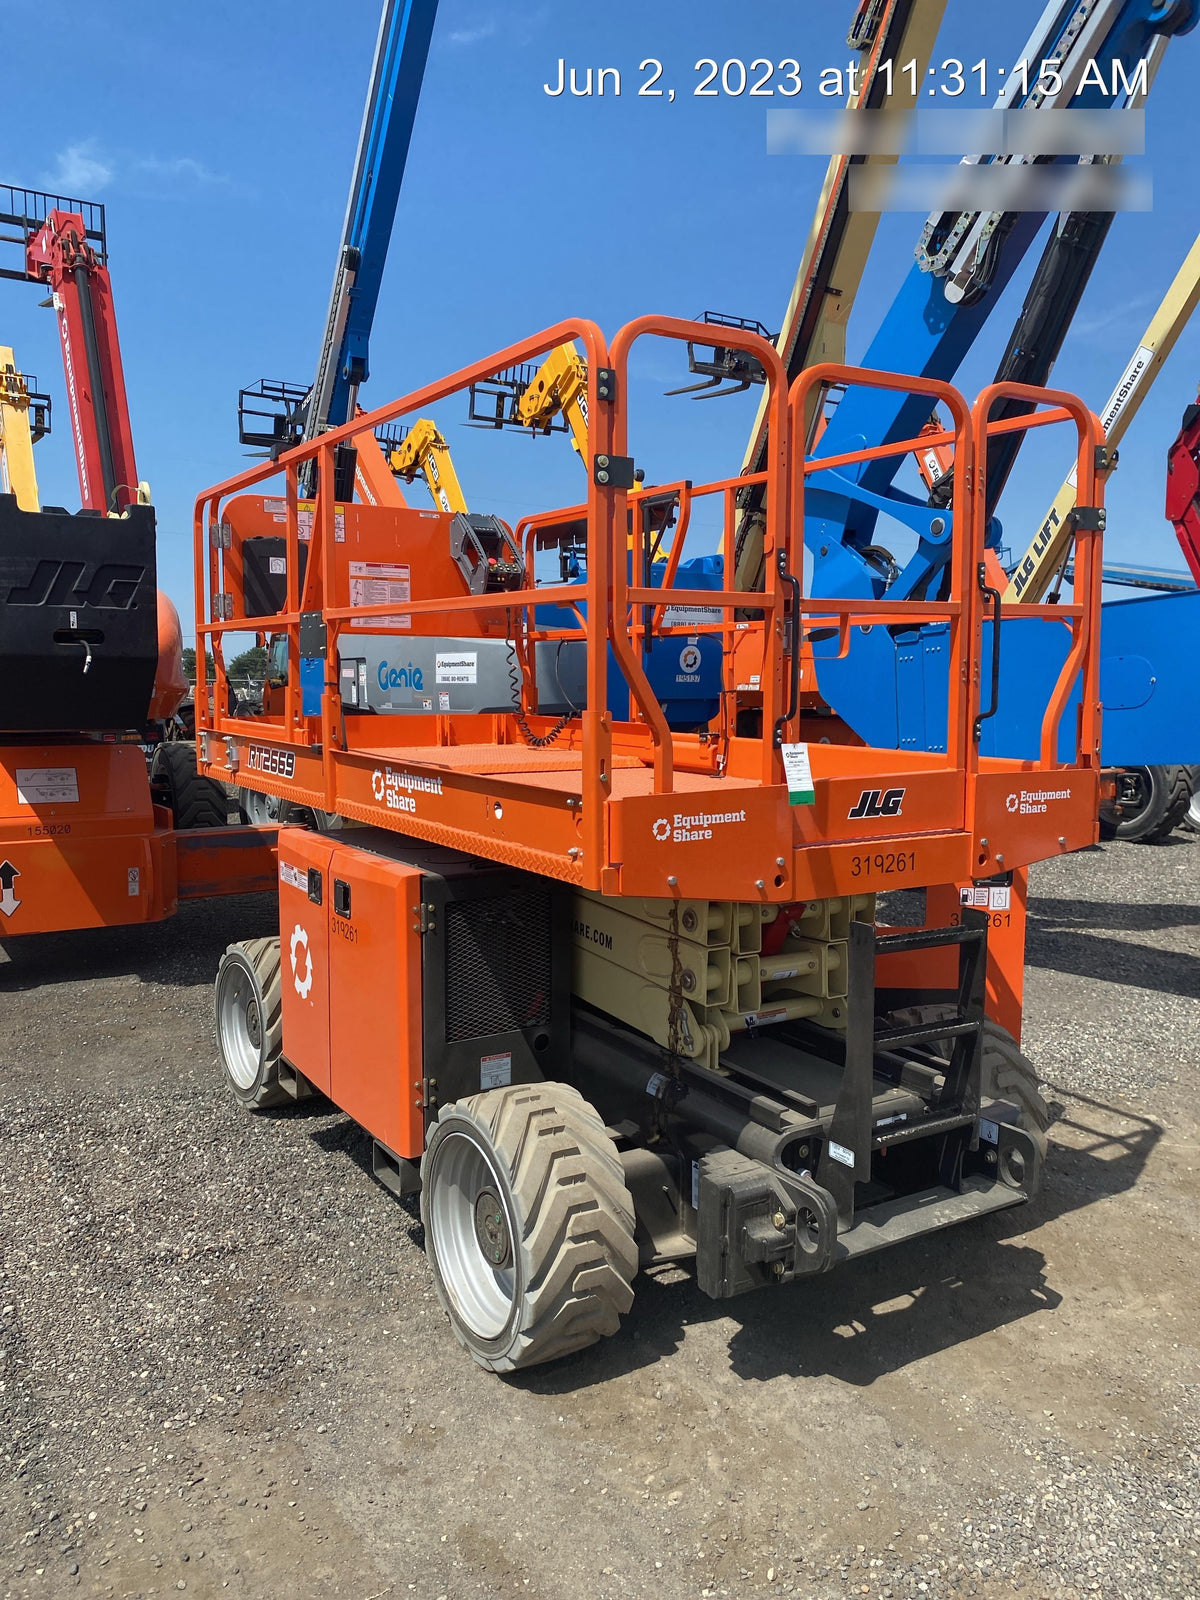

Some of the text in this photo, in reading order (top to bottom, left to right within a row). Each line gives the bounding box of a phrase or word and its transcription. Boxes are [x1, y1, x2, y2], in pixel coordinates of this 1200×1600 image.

[1102, 360, 1144, 433] mentShare
[427, 453, 440, 481] JCB
[1013, 507, 1060, 597] JLG LIFT
[8, 560, 146, 609] JLG
[671, 604, 721, 615] EquipmentShare
[377, 660, 424, 691] Genie
[248, 744, 296, 779] RT2669
[385, 766, 443, 795] Equipment
[385, 788, 416, 813] Share
[847, 787, 906, 820] JLG
[1020, 788, 1071, 802] Equipment
[1020, 801, 1048, 814] Share
[27, 824, 72, 838] 155020
[673, 810, 746, 828] Equipment
[673, 827, 713, 843] Share
[852, 853, 916, 876] 319261
[331, 917, 358, 944] 319261
